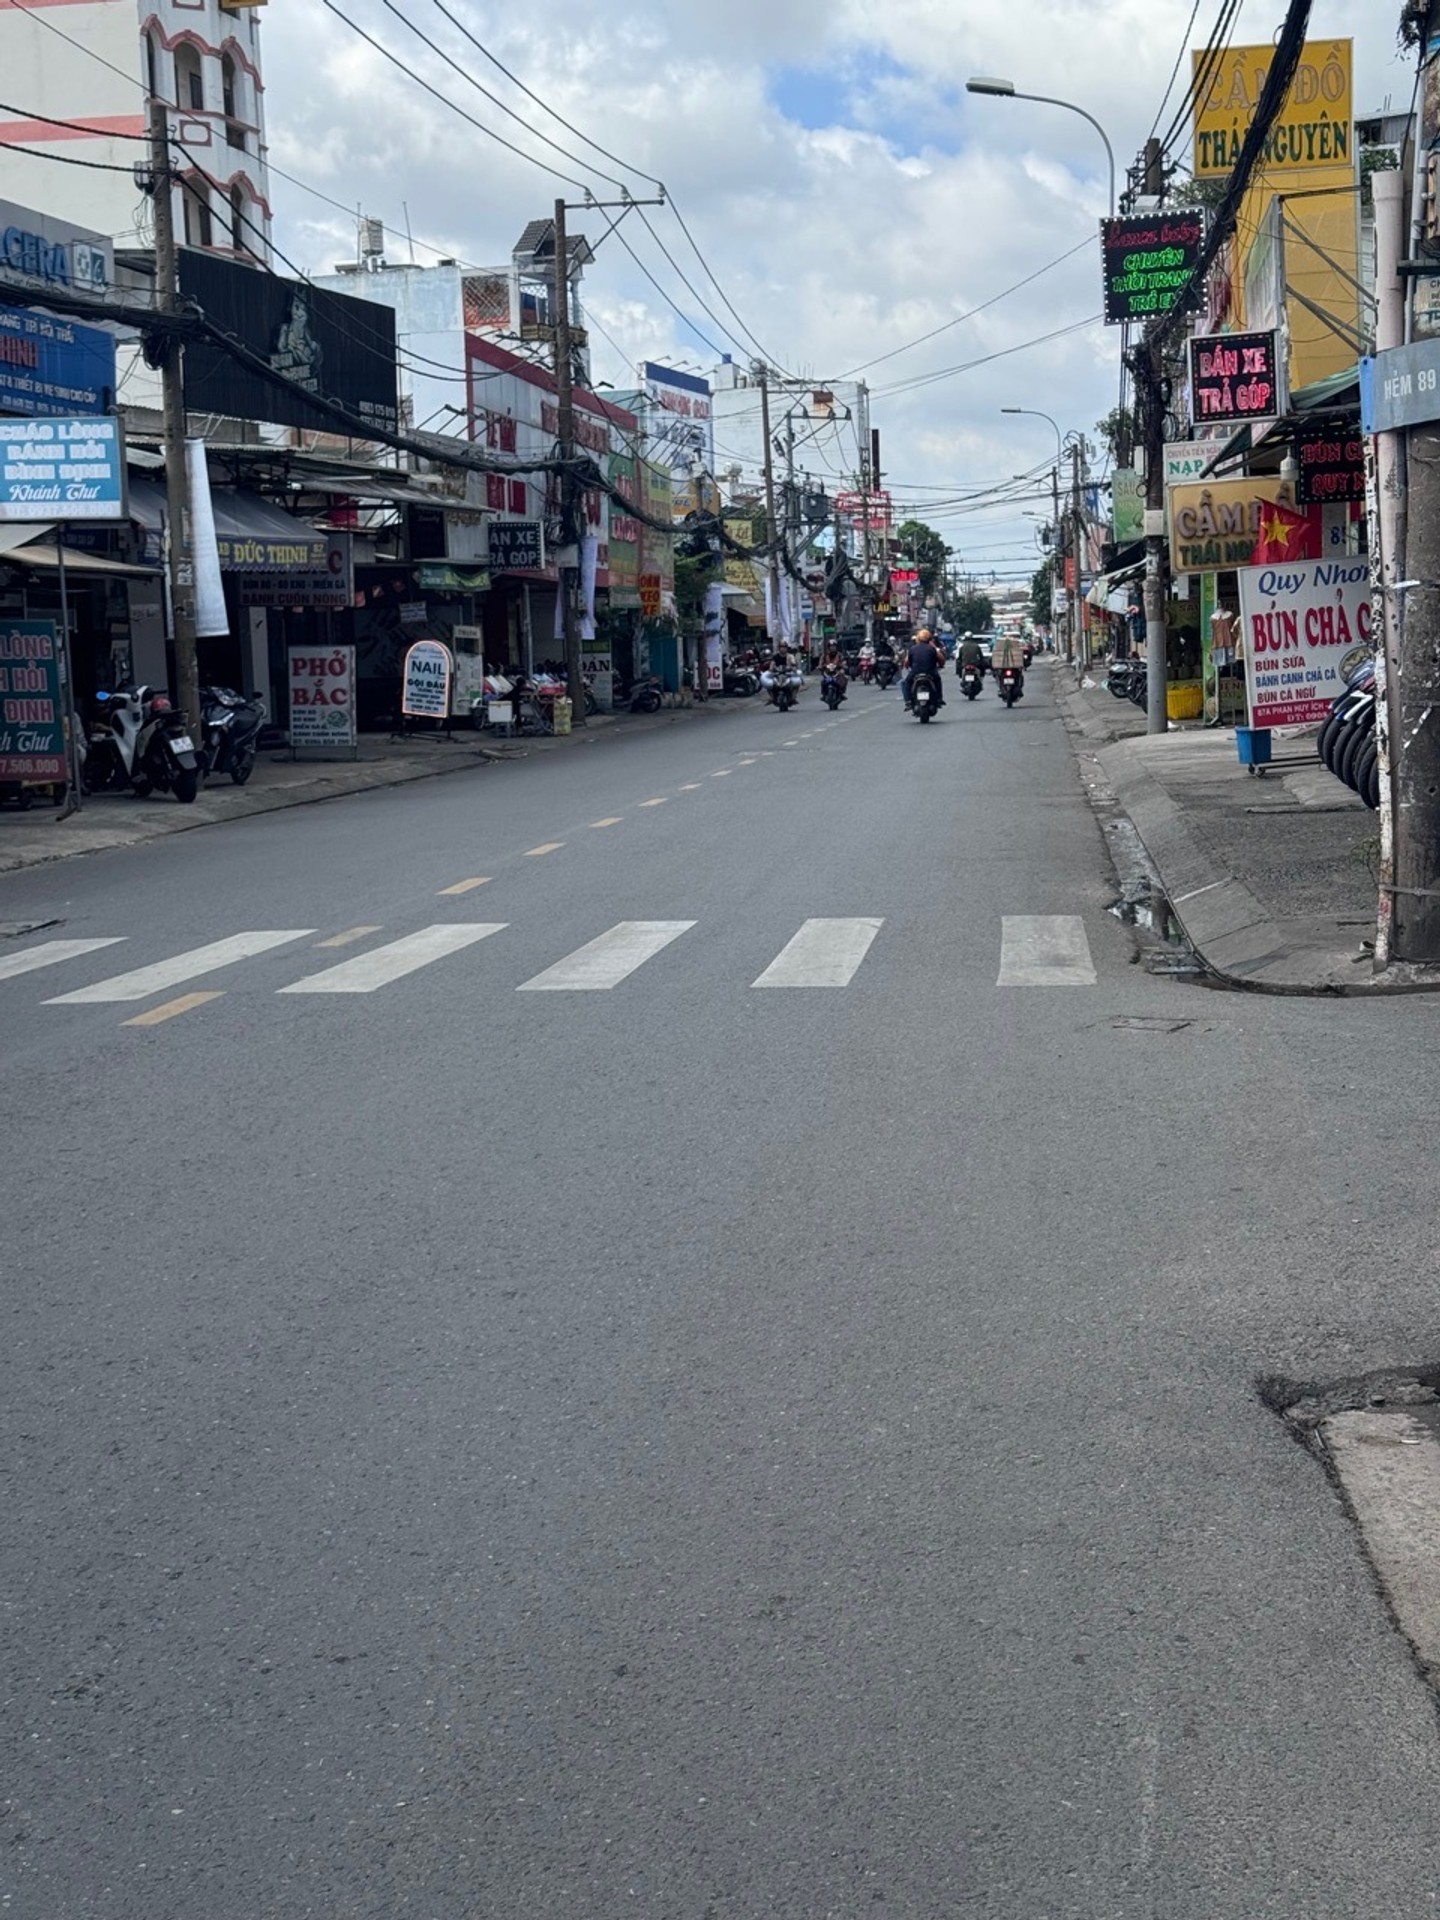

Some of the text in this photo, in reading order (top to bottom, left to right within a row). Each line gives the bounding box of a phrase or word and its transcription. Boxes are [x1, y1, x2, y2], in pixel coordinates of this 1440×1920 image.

[1201, 43, 1345, 111] CẦ ĐỒ
[1199, 117, 1250, 168] THÁ
[0, 226, 70, 286] CERA
[1148, 269, 1194, 289] TRAN
[1199, 344, 1267, 377] BÁN XE
[1199, 376, 1271, 413] TRẢ GÓP
[1384, 369, 1437, 400] HẺM 89
[1169, 459, 1203, 475] NẠP
[9, 483, 101, 501] Khánh Thư
[1176, 489, 1246, 540] CẦM
[489, 529, 536, 546] ÁN XE
[233, 539, 264, 563] ĐỨC
[267, 544, 308, 569] THỊNH
[489, 546, 537, 565] RẢ GÓP
[1258, 570, 1306, 596] Quy
[1251, 600, 1300, 653] BÚN
[1305, 588, 1353, 647] CHẢ
[292, 650, 347, 677] PHỞ
[411, 660, 445, 676] NAIL
[1255, 658, 1279, 672] BÚN
[292, 678, 348, 706] BẮC
[1257, 689, 1277, 704] BÚN
[5, 699, 54, 728] ĐỊNH
[17, 731, 53, 751] Thư
